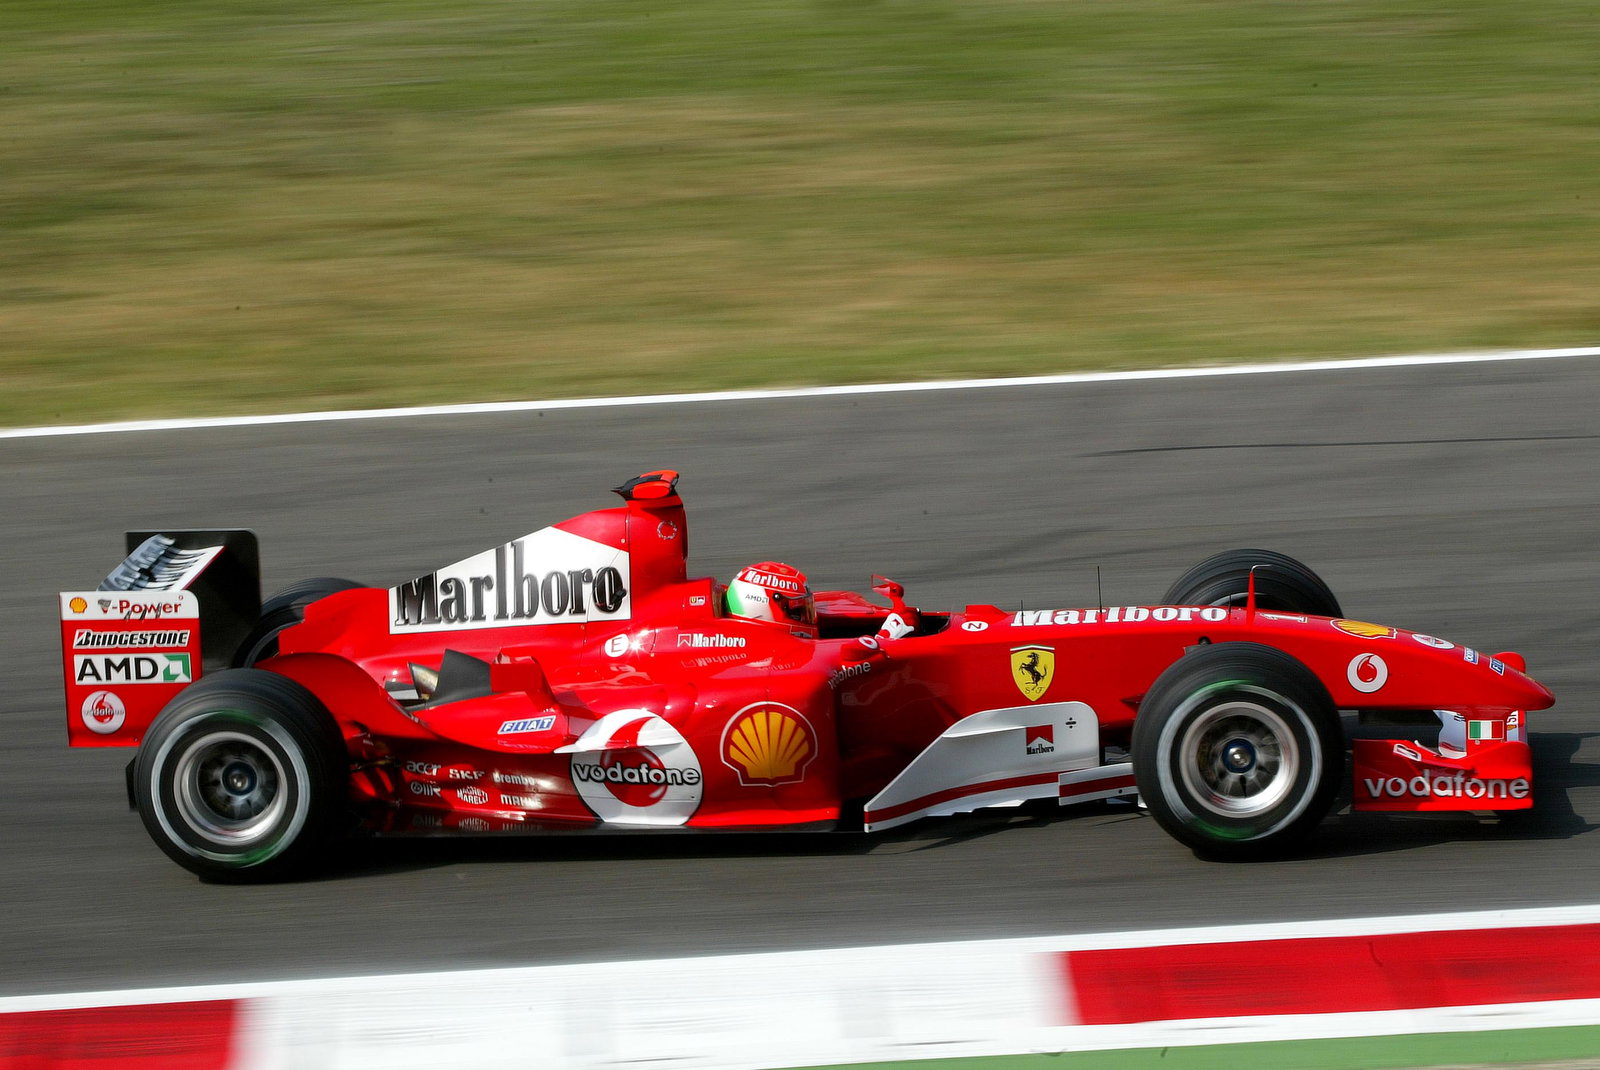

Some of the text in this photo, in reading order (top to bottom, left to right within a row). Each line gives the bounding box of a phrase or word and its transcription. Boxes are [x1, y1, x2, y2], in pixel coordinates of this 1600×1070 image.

[394, 540, 627, 627] Marlboro
[745, 570, 798, 591] Marlboro
[1010, 606, 1227, 627] Marlboro
[75, 630, 188, 647] BRIDGESTONE
[692, 634, 746, 648] Marlboro
[77, 657, 159, 682] AMD
[501, 717, 553, 733] FIAT
[1026, 744, 1055, 755] Marlboro
[406, 761, 442, 776] acer
[449, 768, 485, 780] SKF
[574, 762, 699, 785] vodafone
[1365, 769, 1529, 799] vodafone
